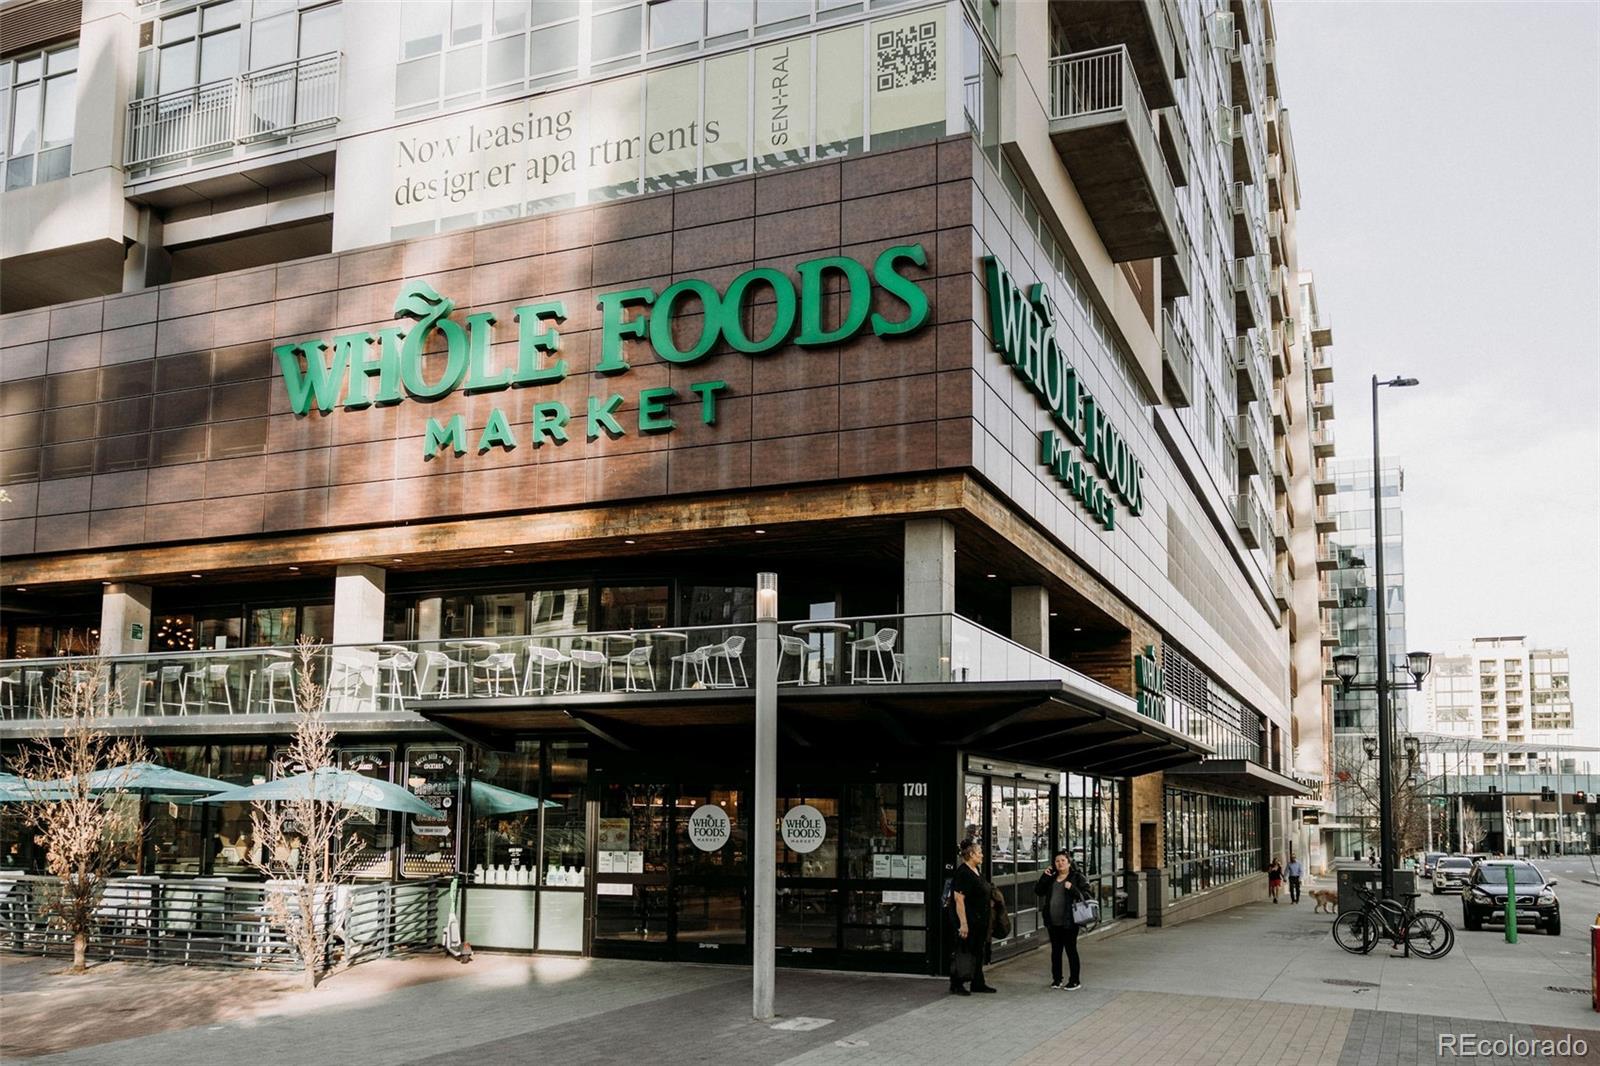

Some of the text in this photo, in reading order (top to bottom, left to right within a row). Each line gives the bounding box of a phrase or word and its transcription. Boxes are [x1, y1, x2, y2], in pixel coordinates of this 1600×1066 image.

[397, 109, 573, 168] Now leasing
[272, 242, 933, 418] WHOLE FOODS
[984, 254, 1145, 518] WHOLE FOODS
[423, 379, 731, 462] MARKET
[1041, 429, 1117, 531] MARKET
[1136, 647, 1166, 696] WHOLE
[903, 782, 928, 797] 1701
[692, 815, 726, 828] WHOLE
[693, 828, 727, 837] FOODS
[785, 816, 822, 829] WHOLE
[787, 829, 822, 839] FOODS
